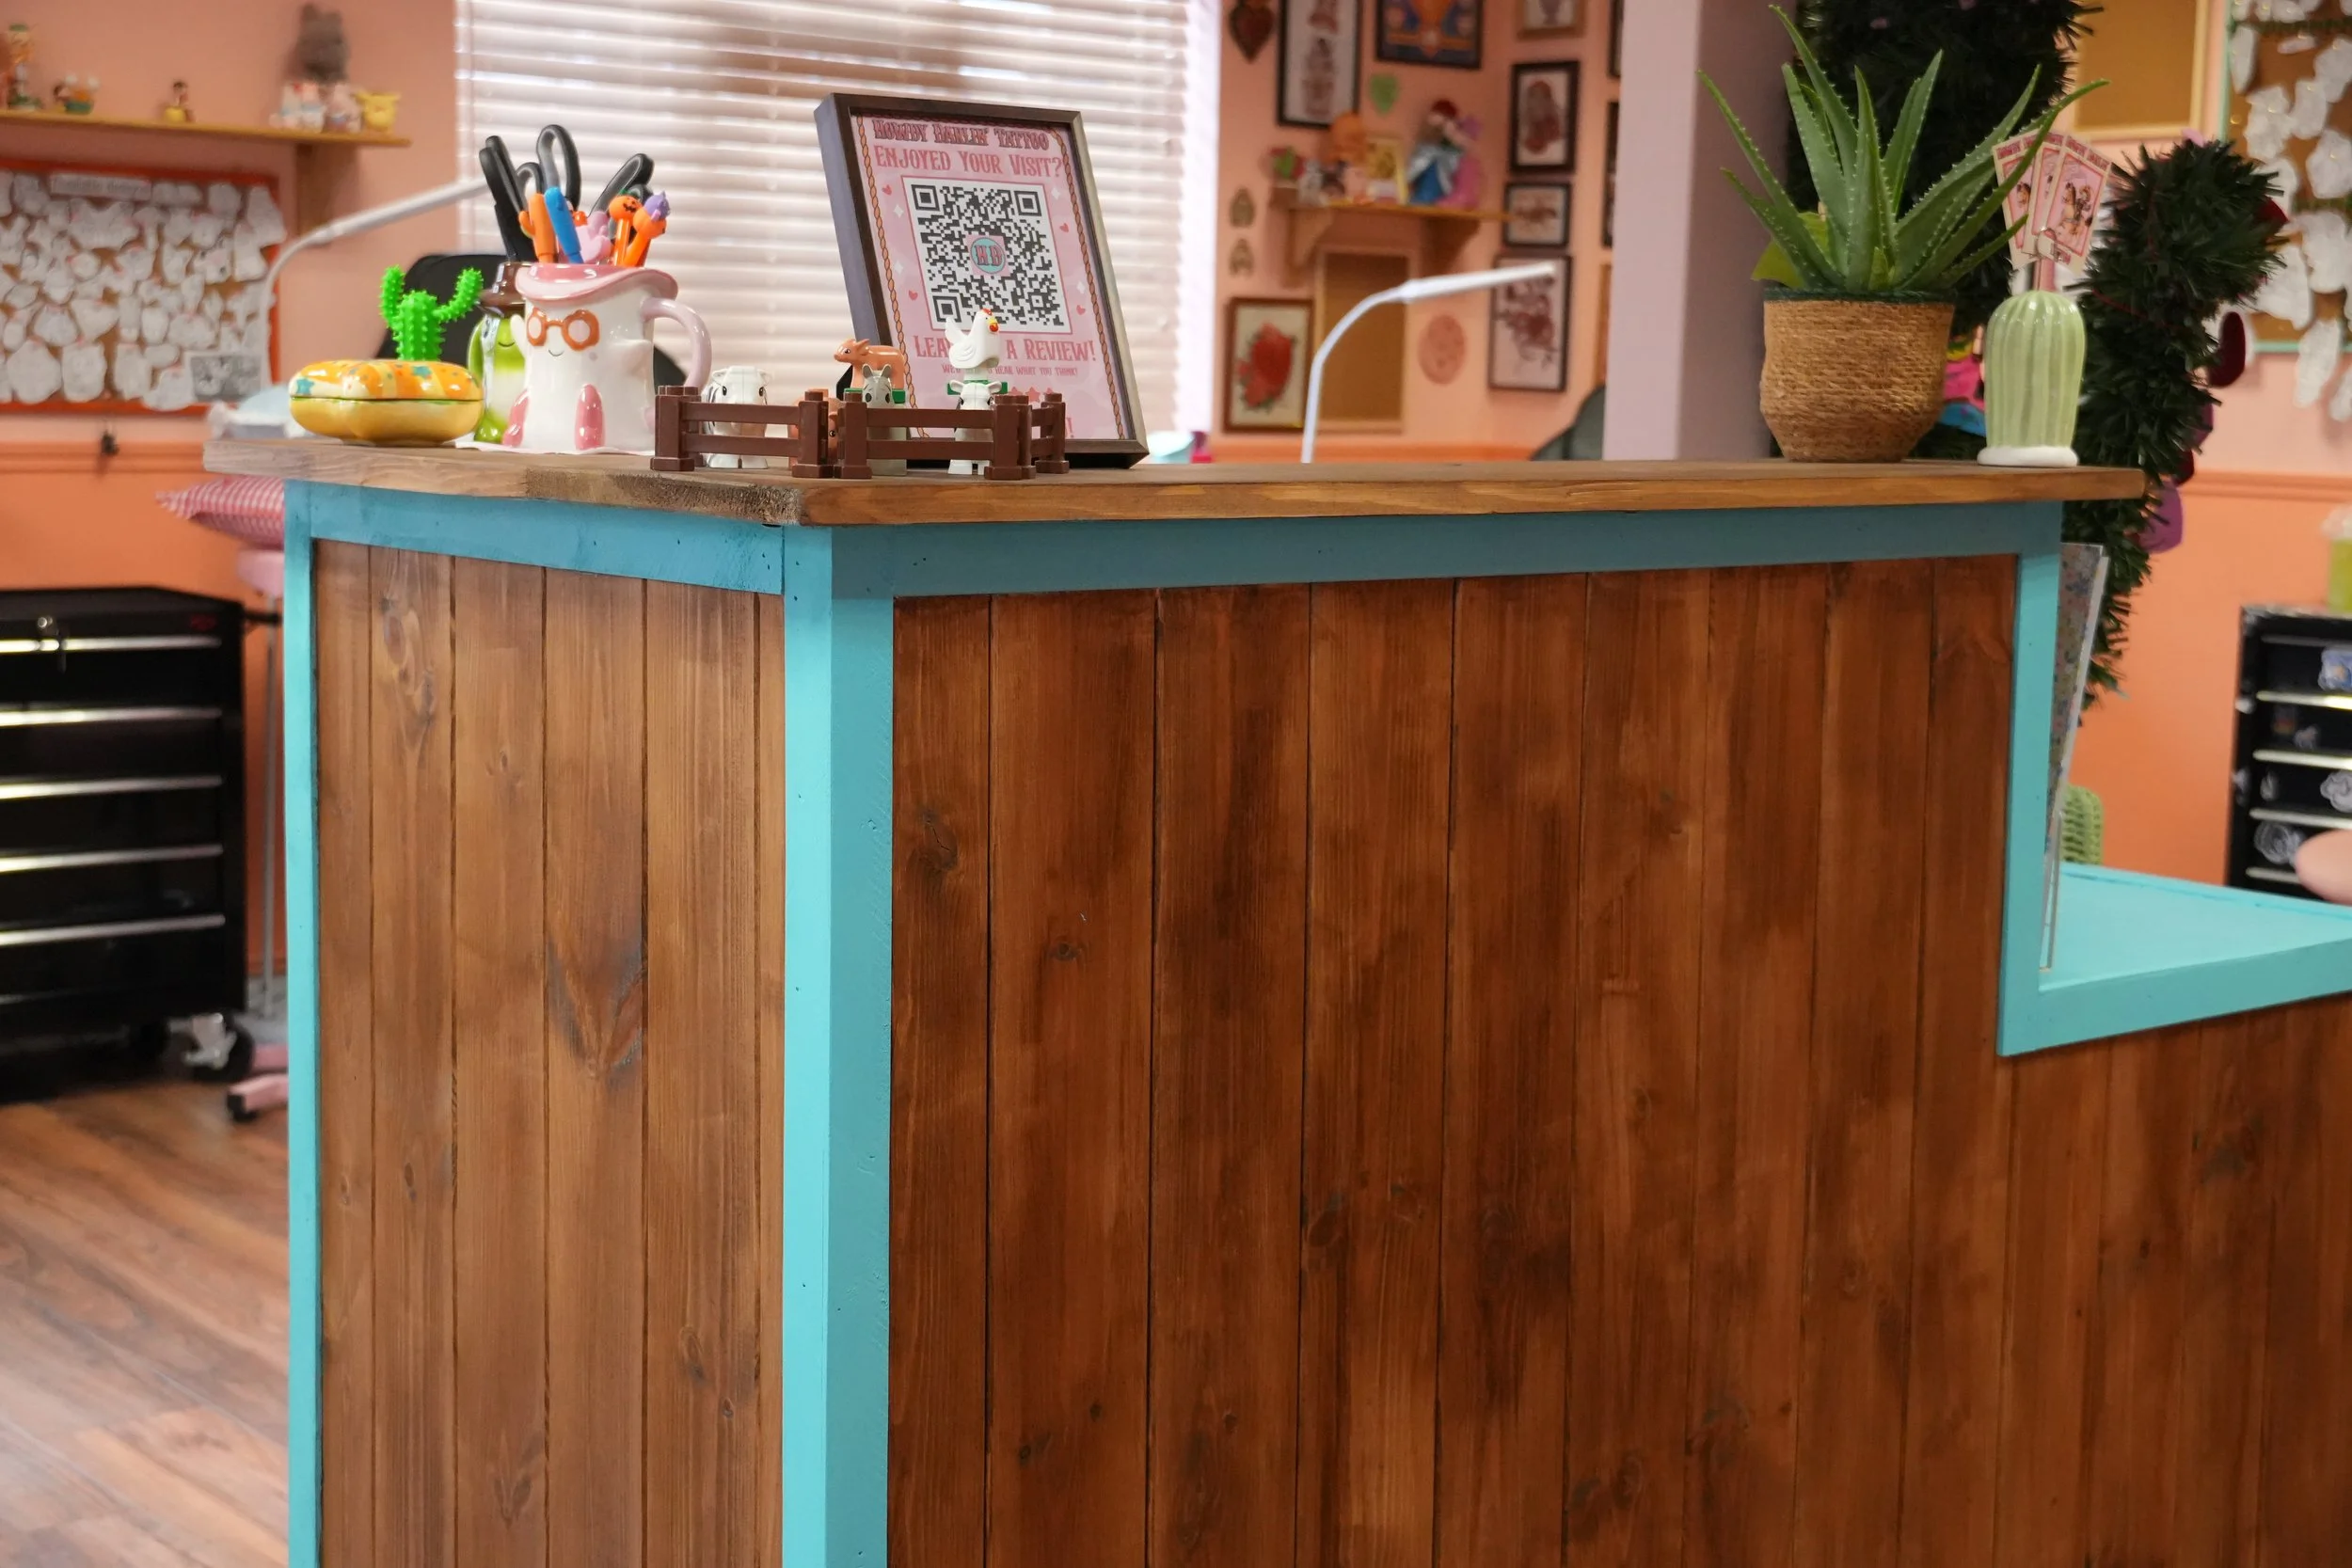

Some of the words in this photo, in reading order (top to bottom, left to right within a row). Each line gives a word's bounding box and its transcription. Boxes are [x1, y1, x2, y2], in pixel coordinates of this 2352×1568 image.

[871, 119, 928, 142] HOWDY
[993, 128, 1050, 150] TATTOO
[874, 145, 951, 170] ENJOYED
[958, 150, 1004, 174] YOUR
[1009, 154, 1064, 177] VISIT?
[913, 335, 952, 358] LEA
[1006, 339, 1018, 359] A
[1024, 338, 1097, 361] REVIEW!
[1016, 366, 1036, 375] WHAT
[1039, 367, 1052, 376] YOU
